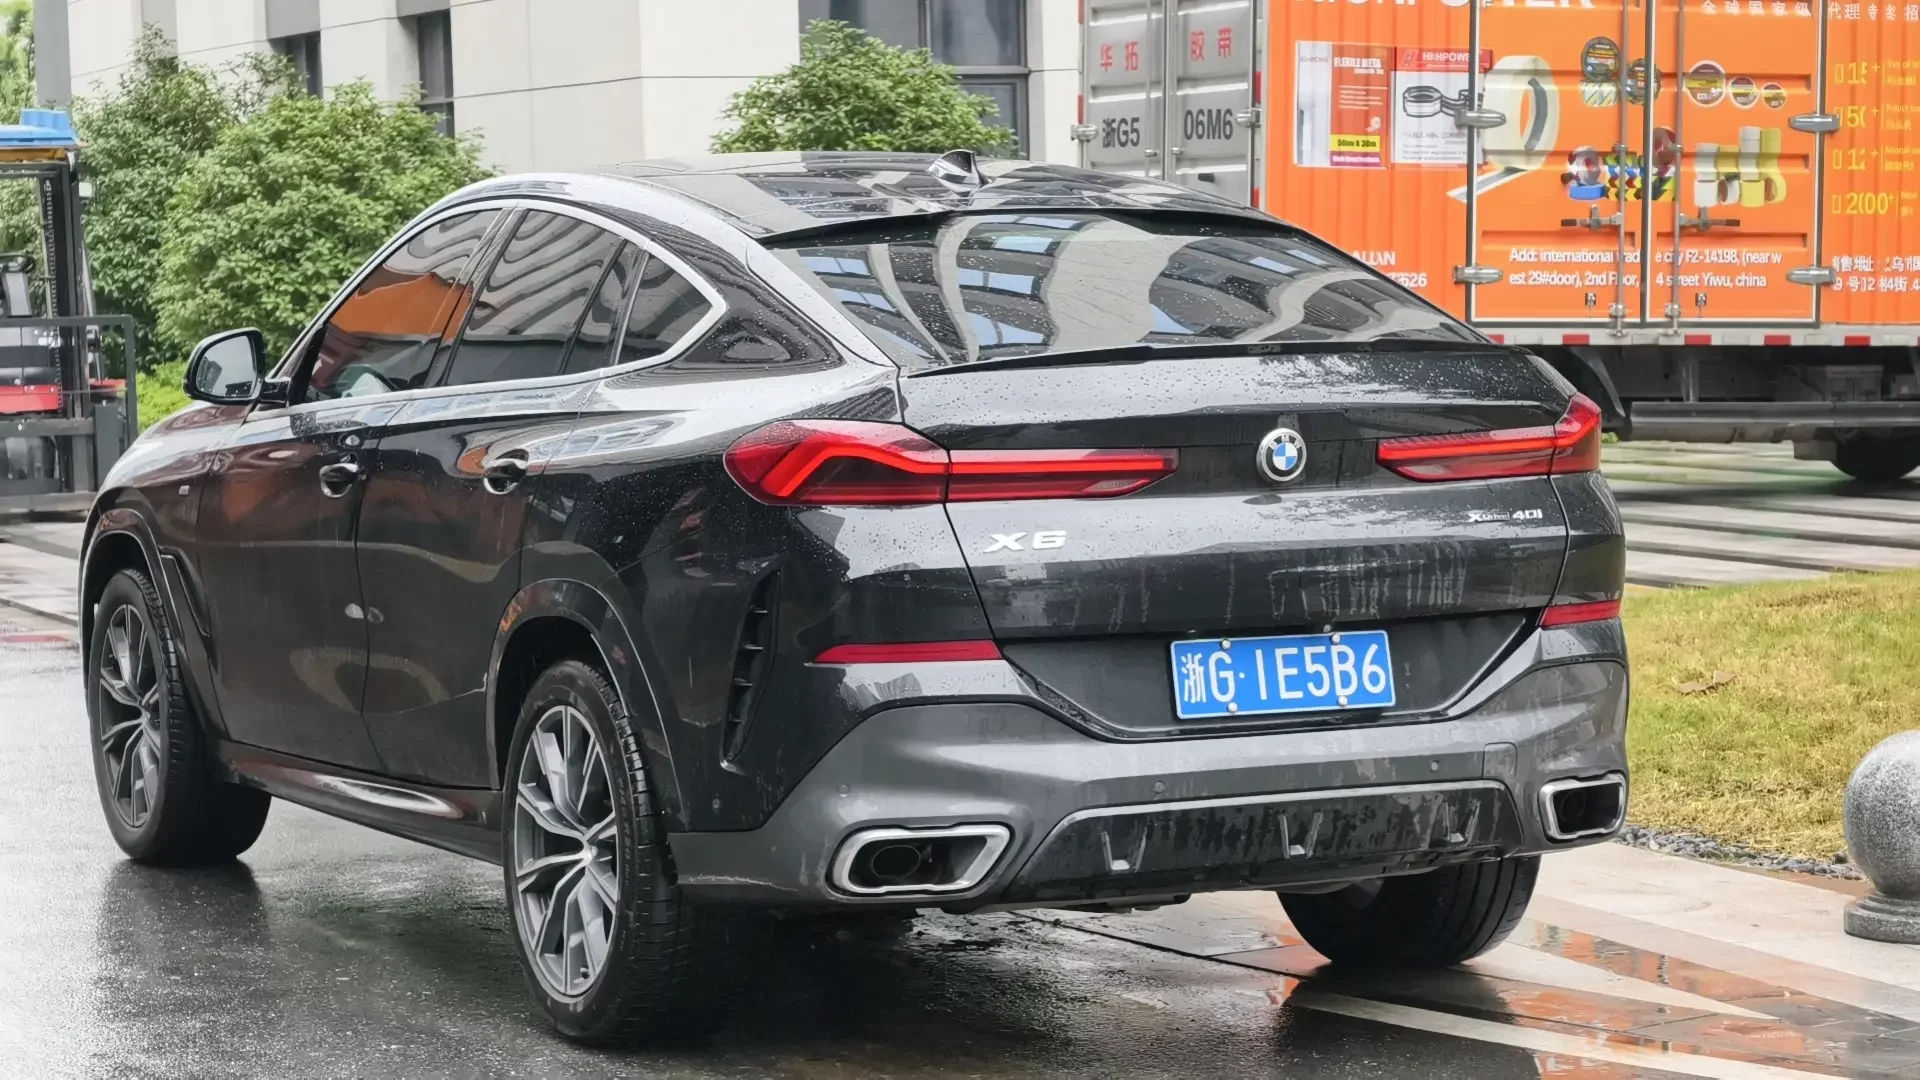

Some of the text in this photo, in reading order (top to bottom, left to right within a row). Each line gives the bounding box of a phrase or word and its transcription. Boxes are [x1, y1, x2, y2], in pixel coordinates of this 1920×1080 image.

[1183, 108, 1234, 140] 06M6
[1736, 272, 1767, 287] china
[982, 530, 1067, 554] X6
